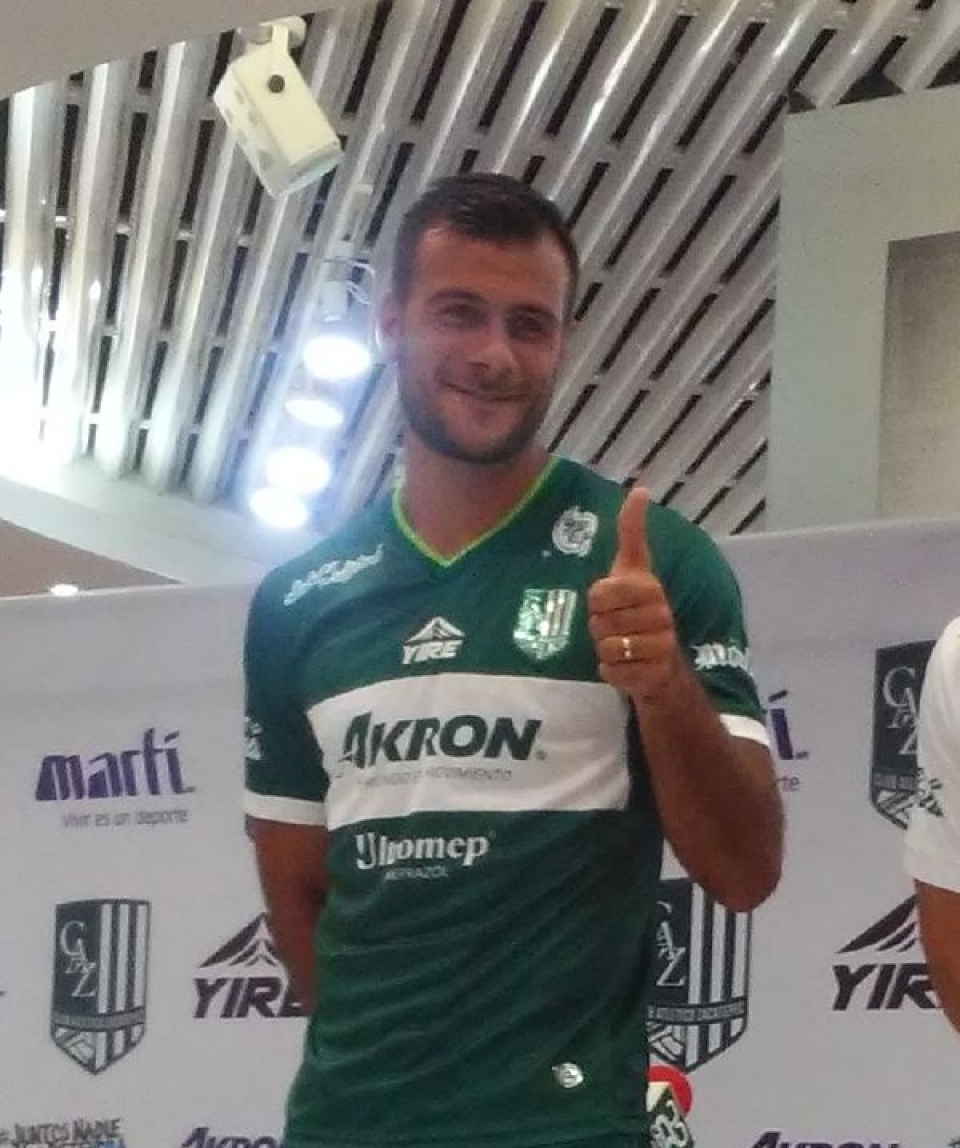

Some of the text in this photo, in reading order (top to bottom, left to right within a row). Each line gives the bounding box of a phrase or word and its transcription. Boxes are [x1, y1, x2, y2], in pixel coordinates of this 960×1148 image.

[402, 639, 463, 665] YIRE
[339, 712, 543, 769] AKRON
[832, 963, 944, 1011] YIR
